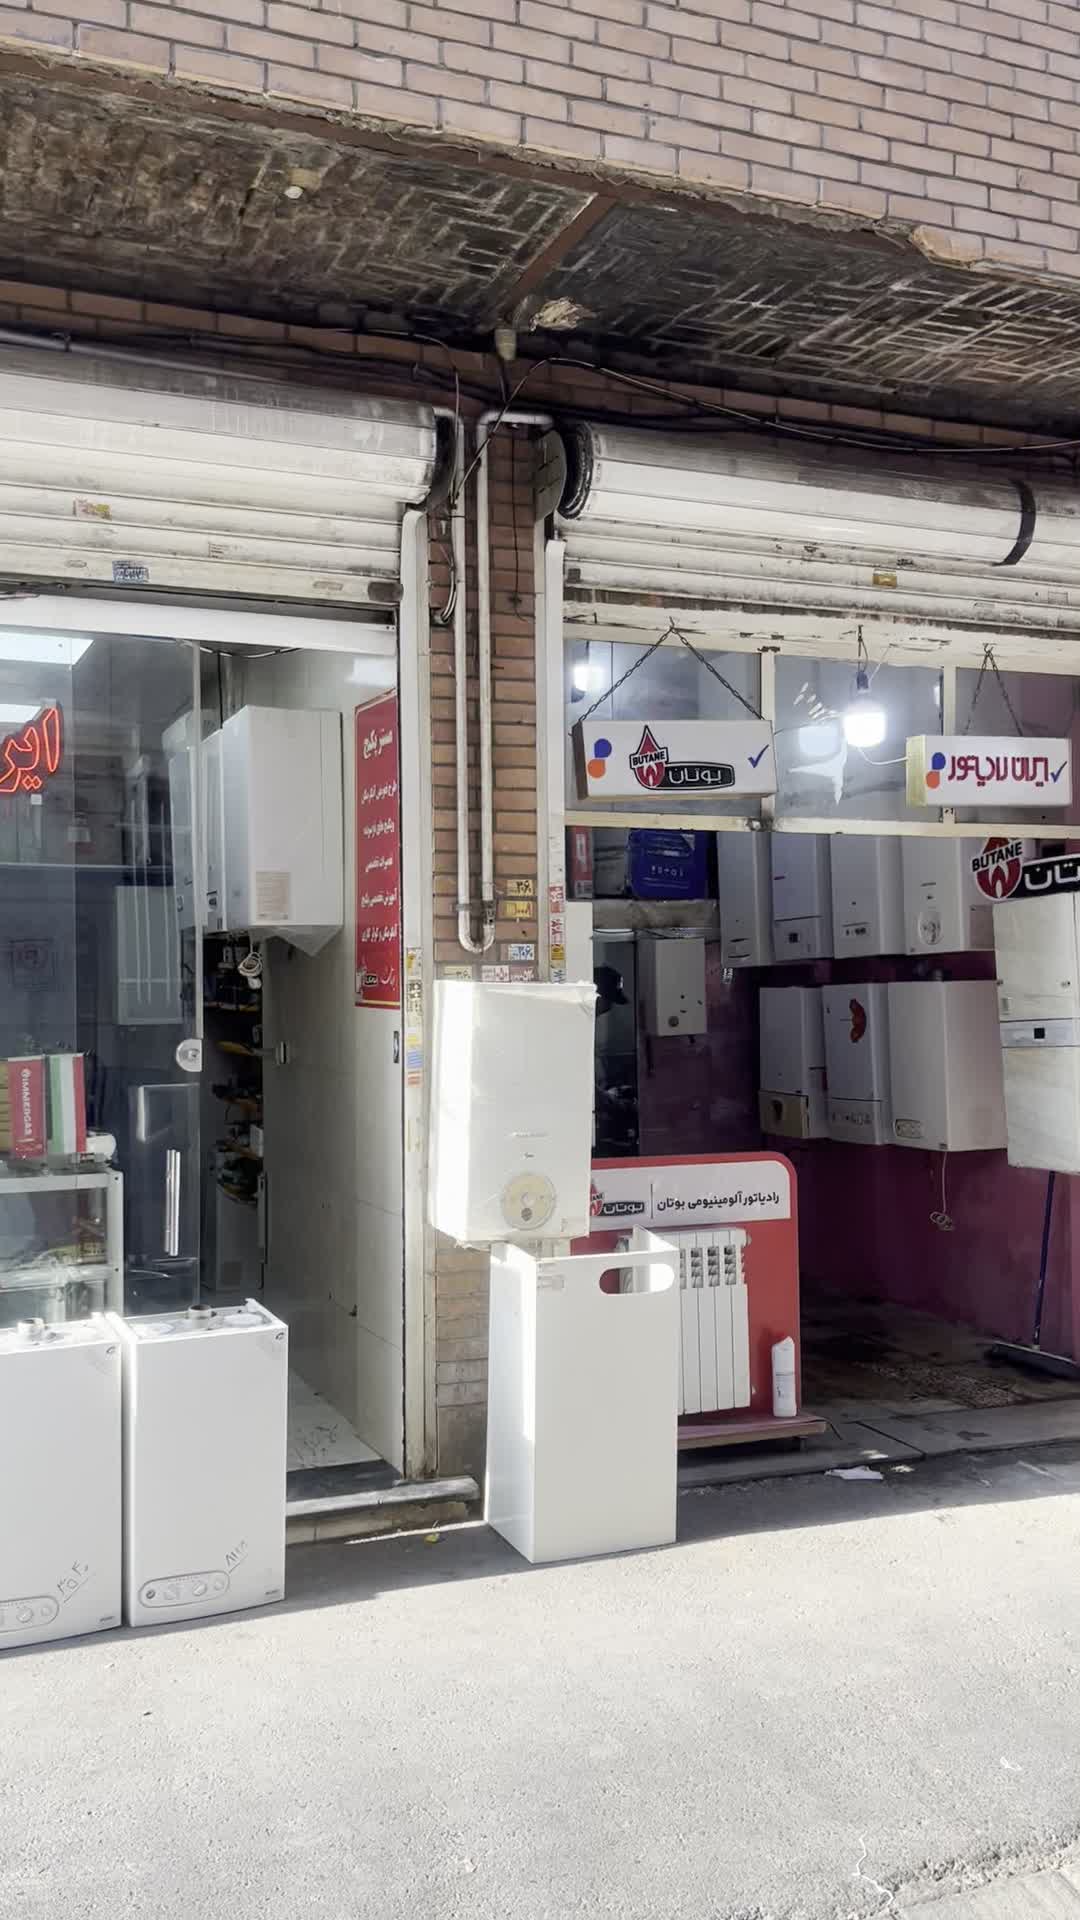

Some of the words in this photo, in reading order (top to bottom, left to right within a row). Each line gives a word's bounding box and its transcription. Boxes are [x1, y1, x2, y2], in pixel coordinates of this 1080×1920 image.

[632, 750, 666, 766] BUTANE
[668, 767, 722, 785] بوتان
[1009, 756, 1050, 787] ایران
[972, 841, 1023, 872] BUTANE
[657, 1196, 686, 1212] بوتان
[688, 1190, 743, 1210] آلومینیومی
[743, 1191, 780, 1205] رادیاتور
[603, 1202, 644, 1215] بوتان
